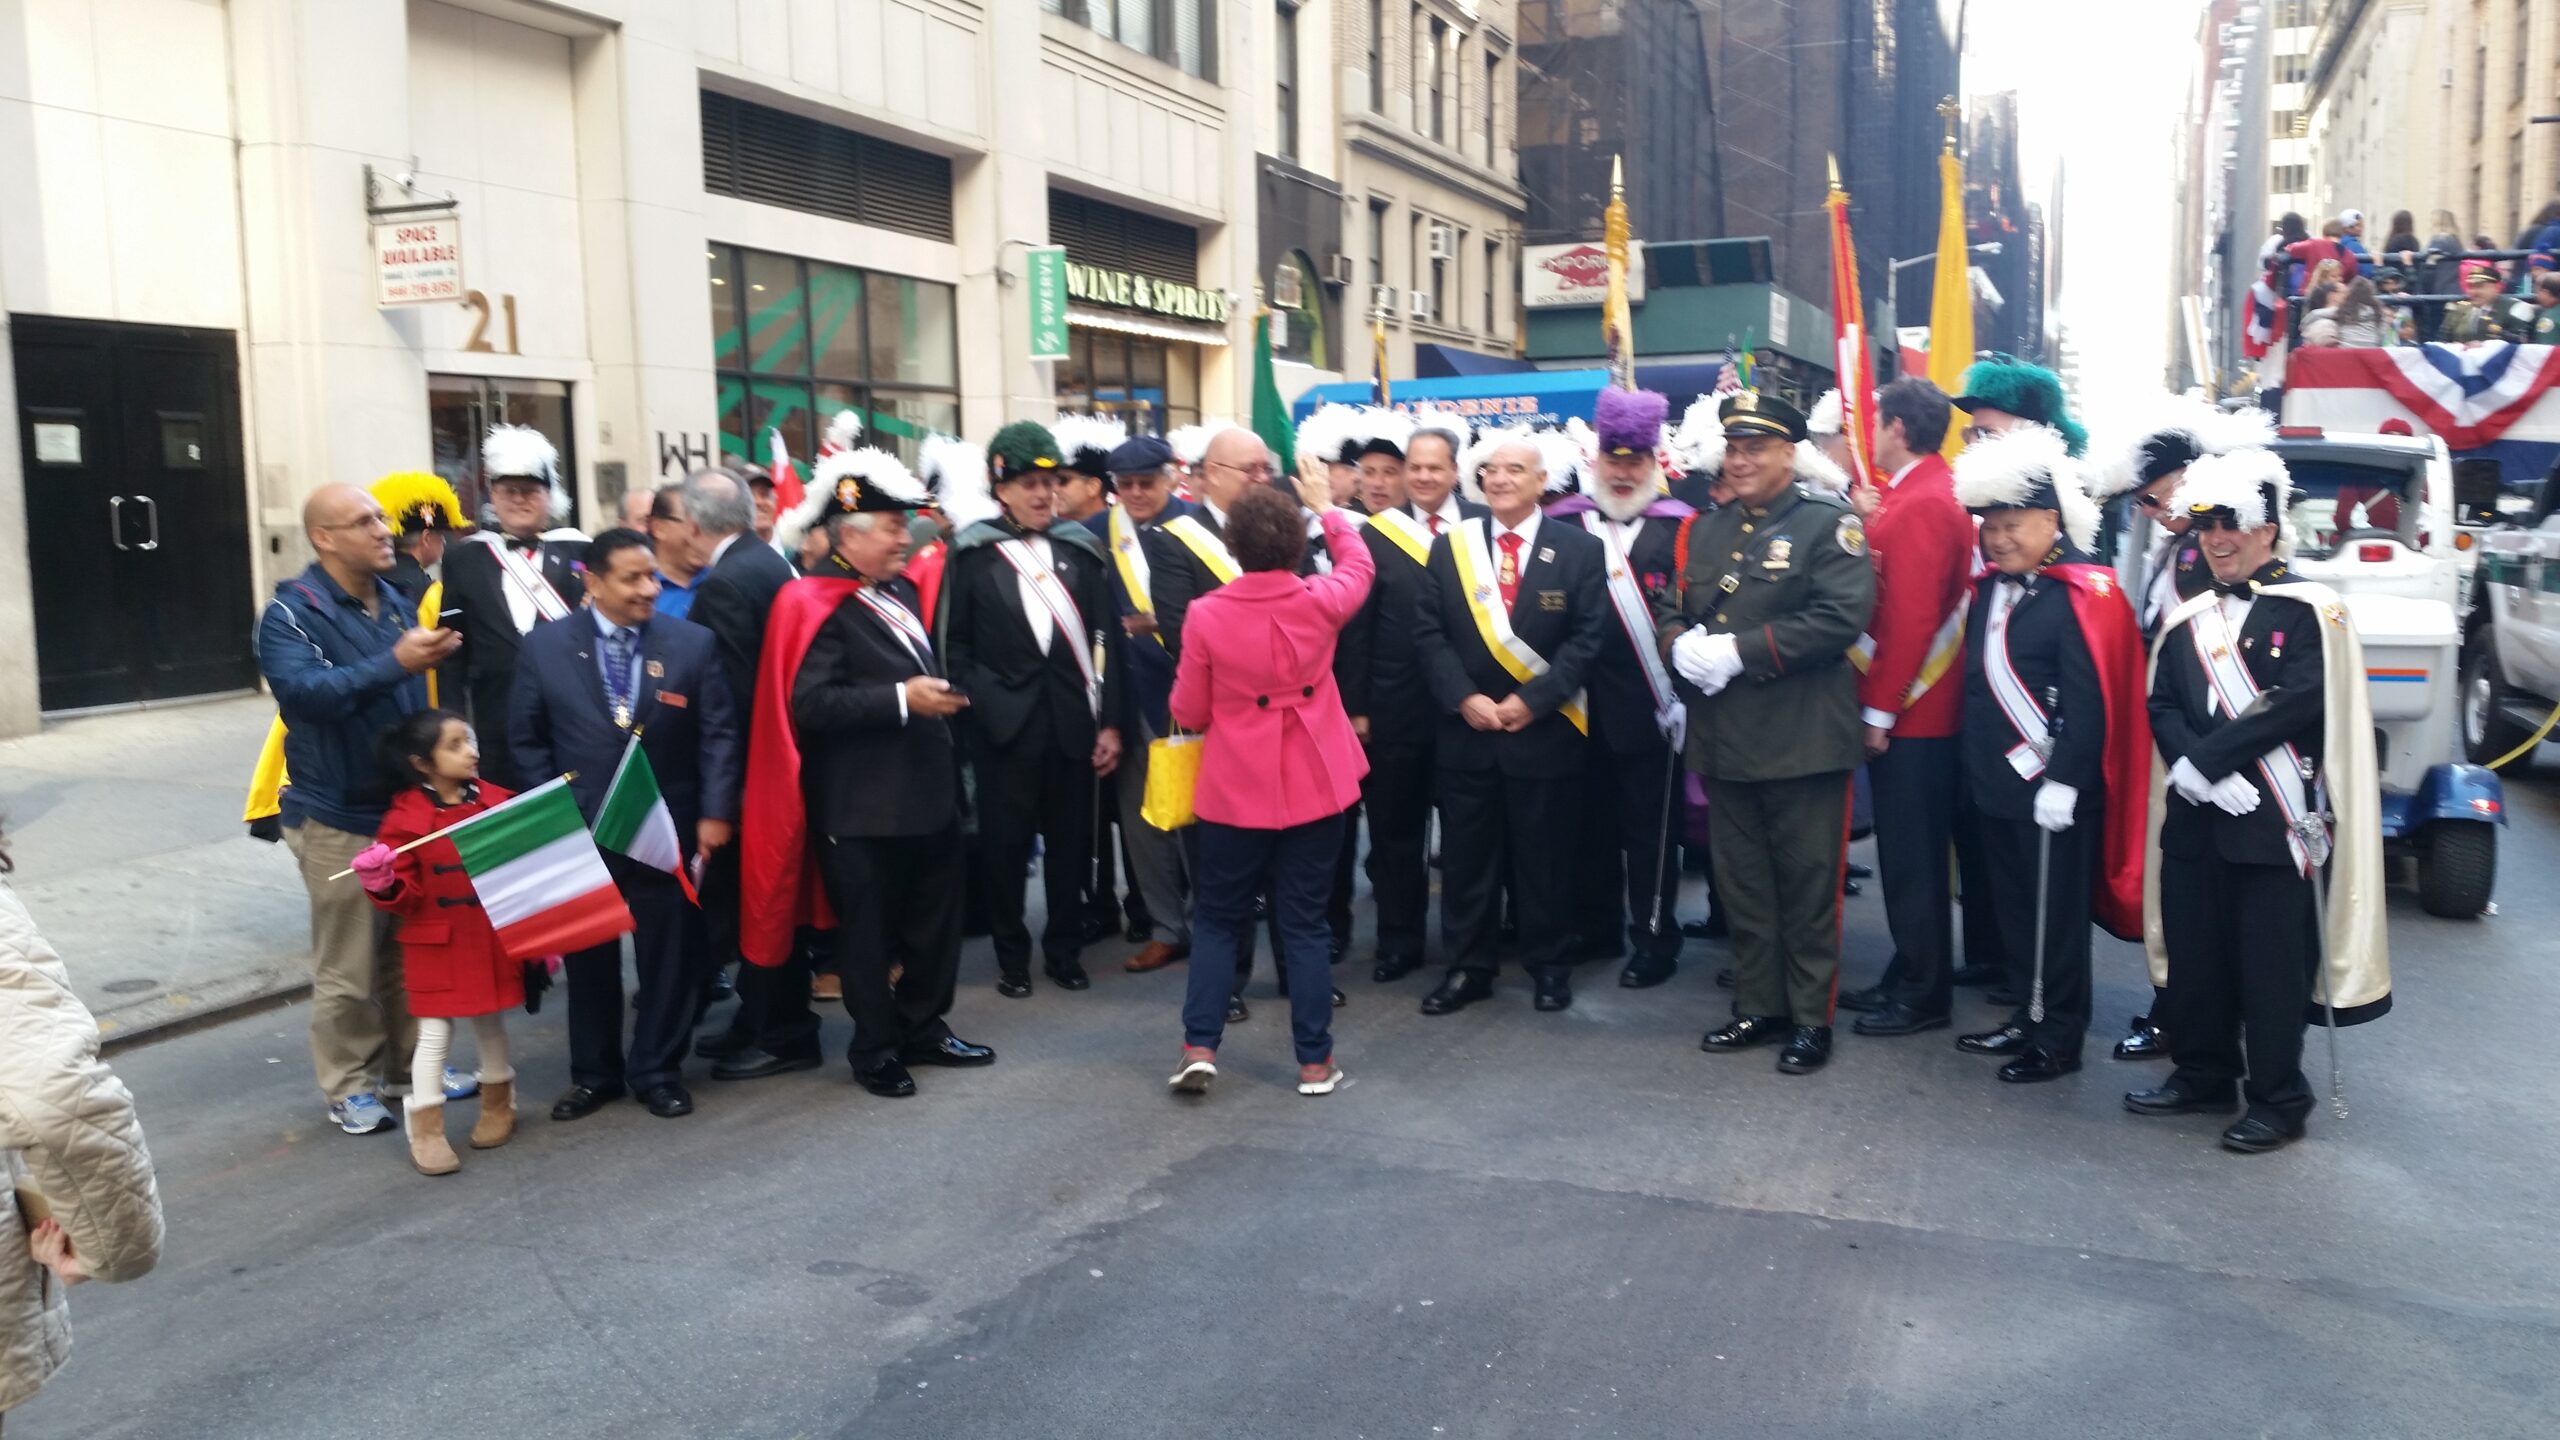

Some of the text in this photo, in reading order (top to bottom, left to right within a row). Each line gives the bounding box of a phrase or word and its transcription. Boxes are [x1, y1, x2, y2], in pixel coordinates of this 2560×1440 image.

[383, 245, 456, 265] AVAILABLE
[396, 225, 437, 244] SPACE
[463, 288, 518, 354] 21
[1039, 254, 1055, 326] SWERVE
[1065, 261, 1228, 323] WINE & SPIRITS
